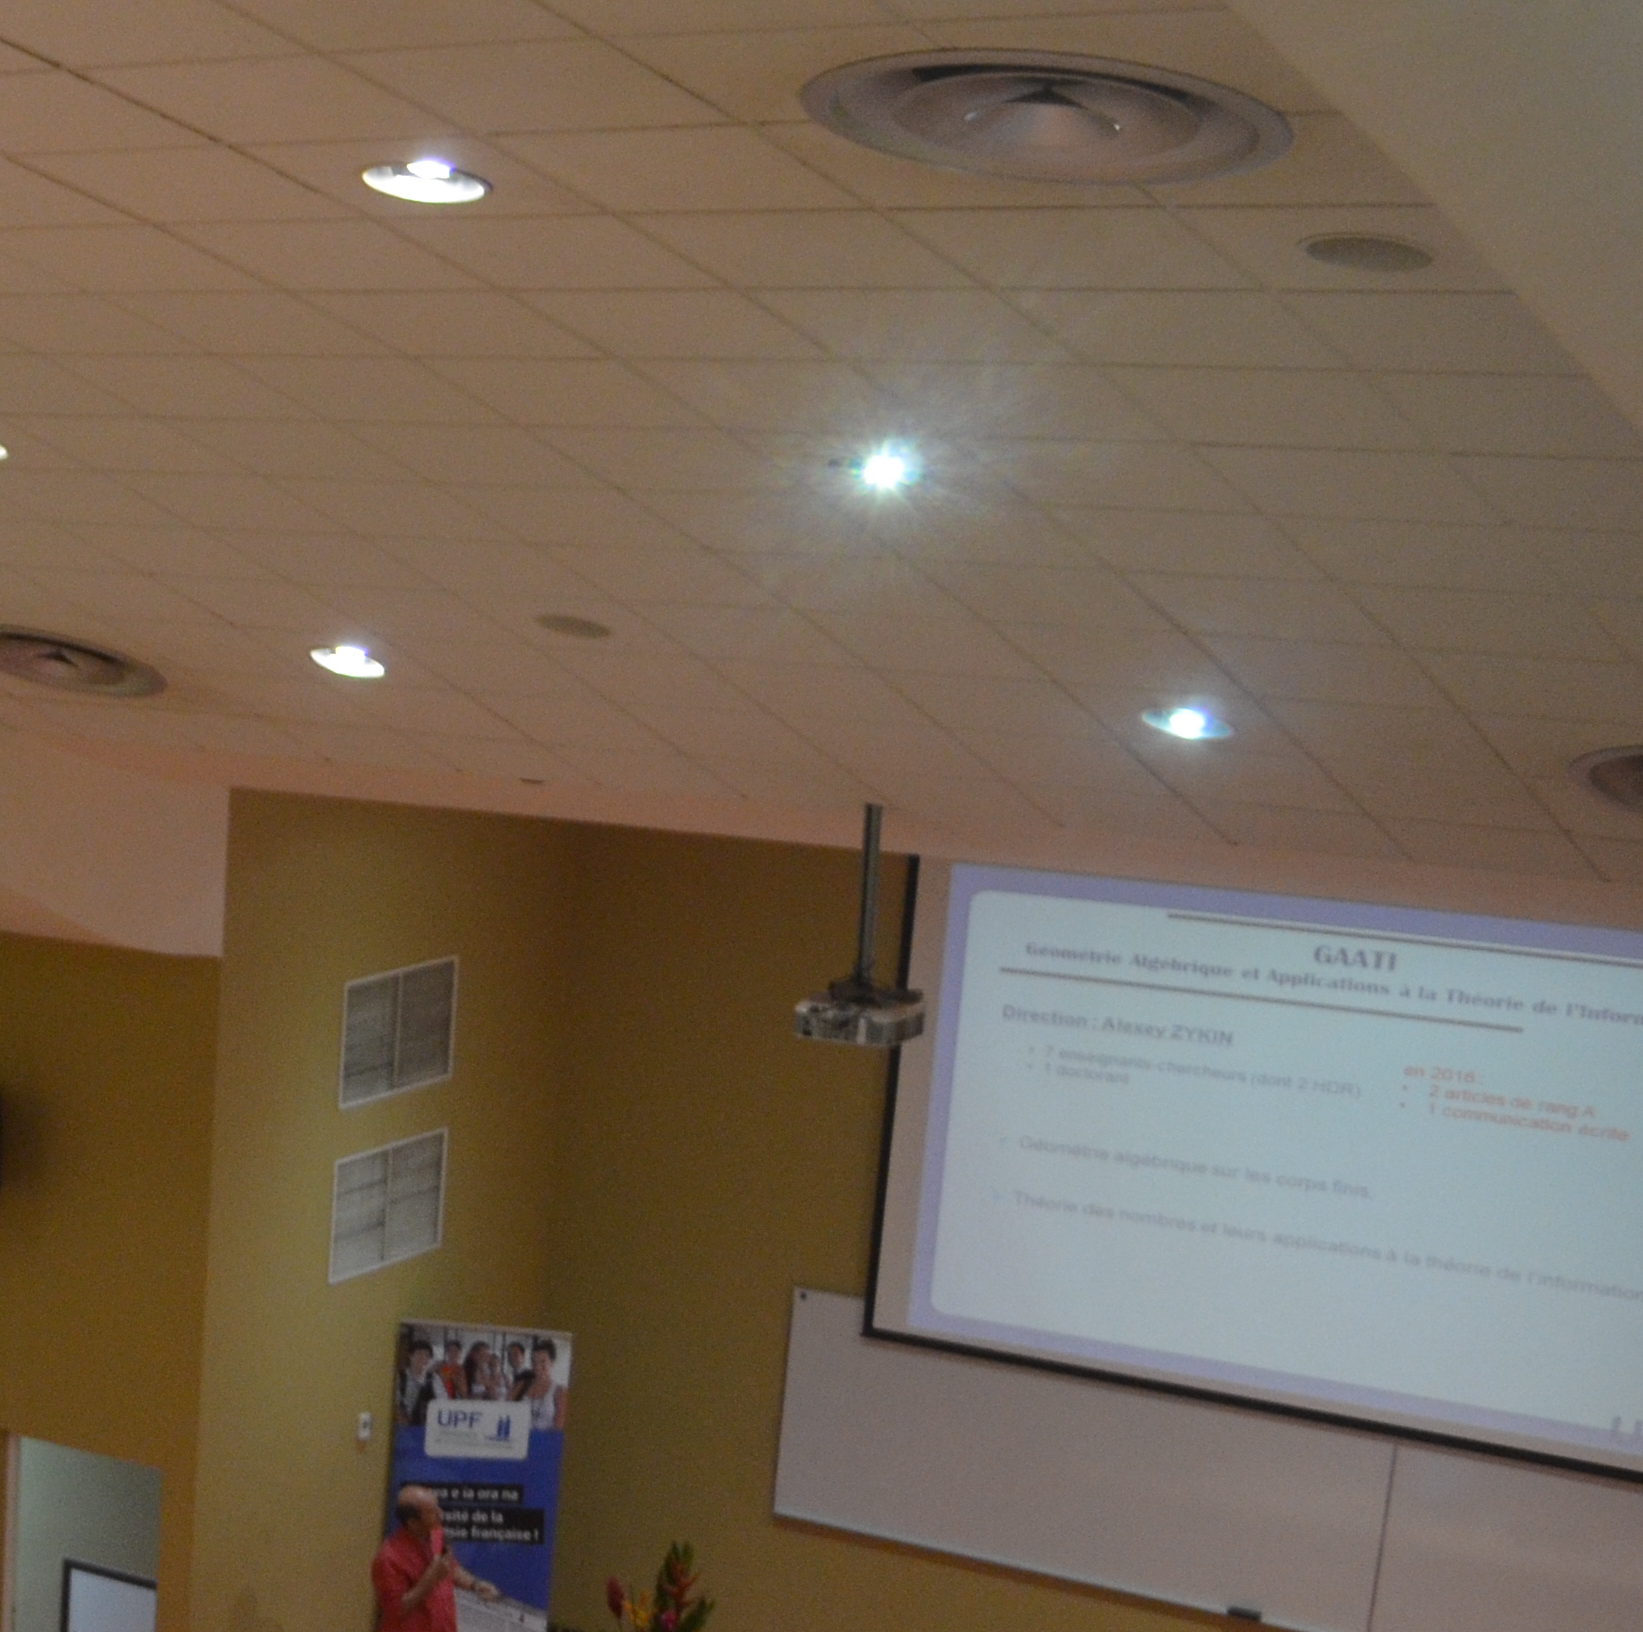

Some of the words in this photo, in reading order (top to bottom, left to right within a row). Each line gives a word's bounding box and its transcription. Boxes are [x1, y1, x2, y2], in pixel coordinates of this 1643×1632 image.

[1313, 944, 1398, 973] GAATI
[1130, 953, 1233, 978] Algébrique
[1241, 967, 1260, 981] et
[1267, 967, 1390, 996] Applications
[1399, 982, 1411, 999] à
[1418, 985, 1438, 1002] la
[1446, 988, 1524, 1012] Théorie
[1531, 999, 1558, 1016] de
[1002, 1003, 1088, 1029] Direction
[1102, 1016, 1166, 1040] Alexey
[1171, 1024, 1235, 1046] ZYKIN
[1403, 1065, 1425, 1080] en
[1444, 1087, 1506, 1109] articles
[1510, 1095, 1532, 1111] de
[1537, 1099, 1579, 1120] rang
[1582, 1104, 1597, 1118] A
[1442, 1104, 1572, 1134] communication
[437, 1409, 482, 1429] UPF
[471, 1510, 489, 1524] de
